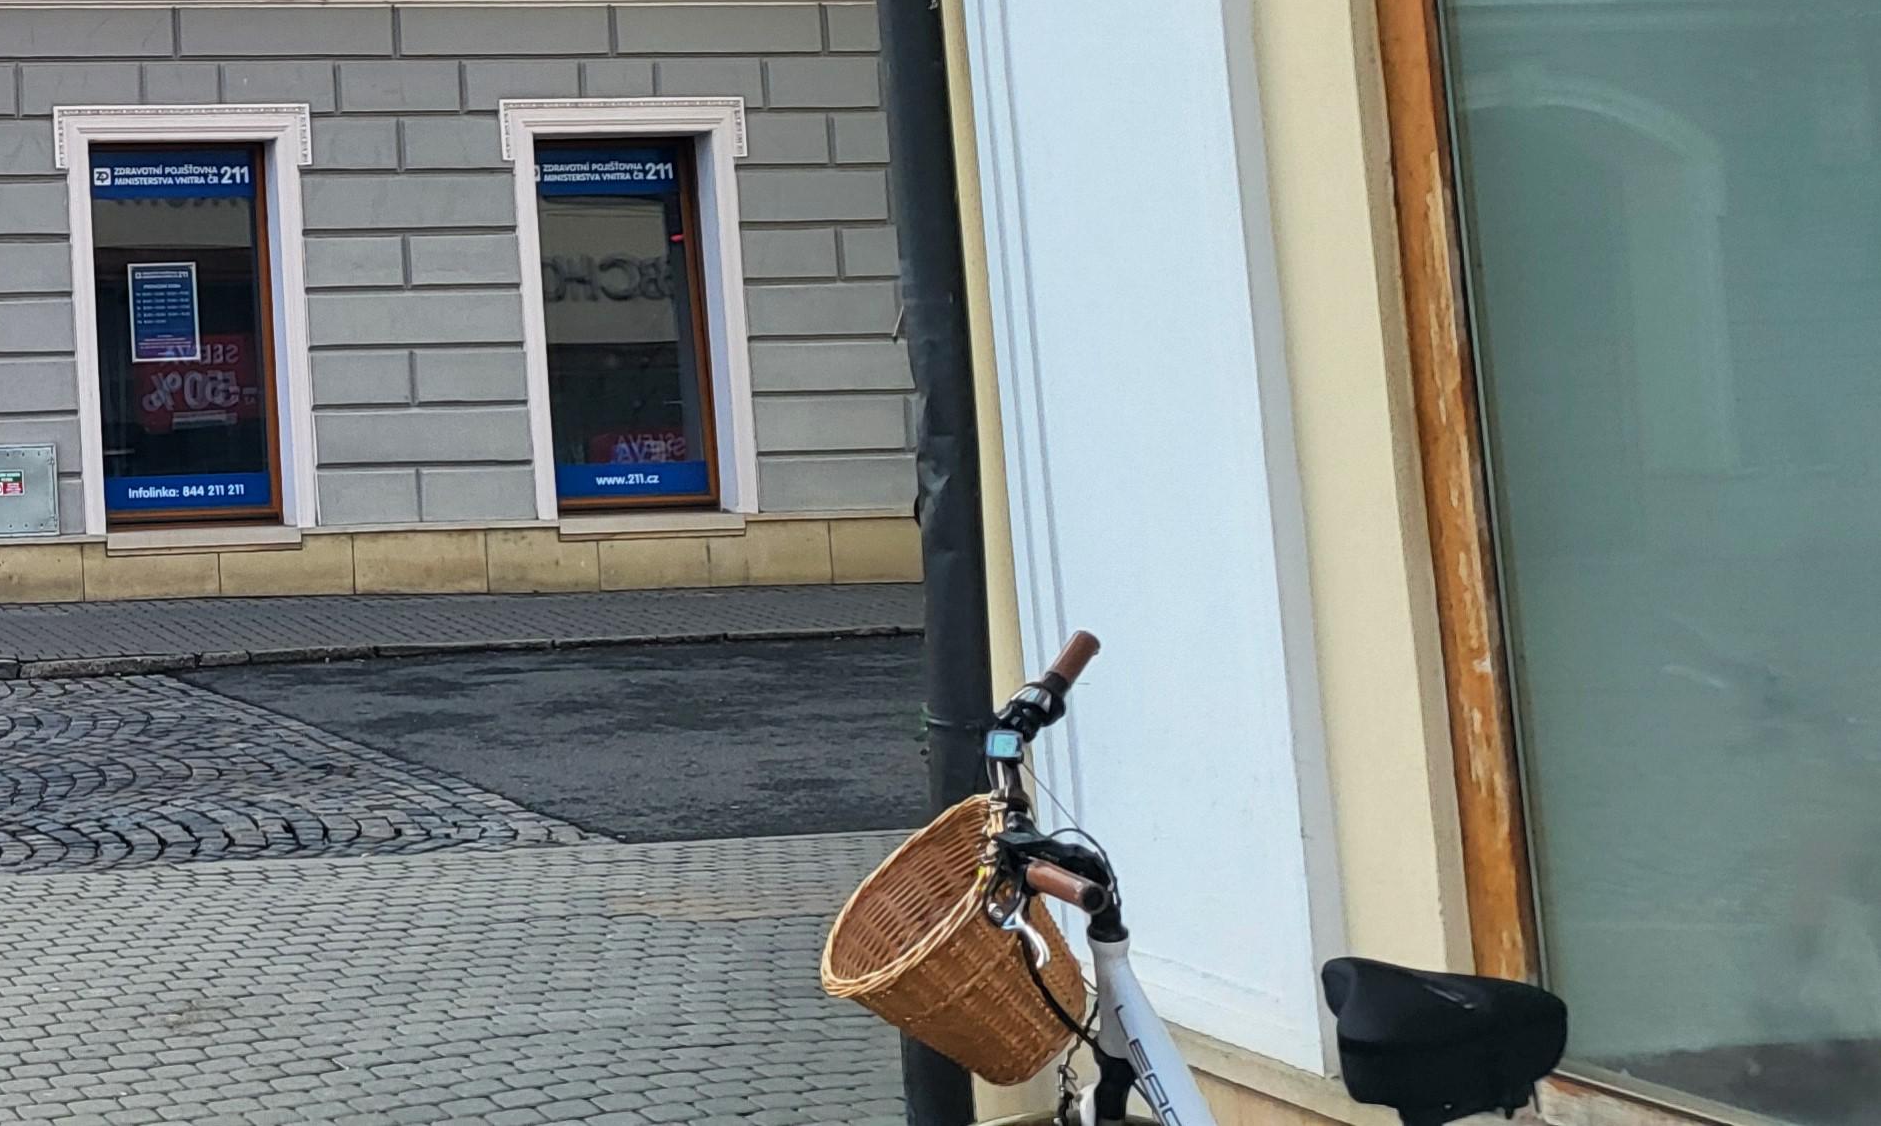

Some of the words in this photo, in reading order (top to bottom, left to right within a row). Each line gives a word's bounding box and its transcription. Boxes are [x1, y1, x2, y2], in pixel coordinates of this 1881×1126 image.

[114, 164, 163, 175] ZDRAVOTNÍ
[220, 166, 250, 184] 211
[645, 162, 674, 180] 211
[114, 176, 174, 186] MINISTERSTVA
[175, 176, 206, 185] VNITRA
[596, 473, 660, 486] www.211.cz
[128, 486, 180, 499] Infolinka:
[182, 485, 205, 497] 844
[207, 484, 225, 496] 211
[227, 483, 245, 495] 211
